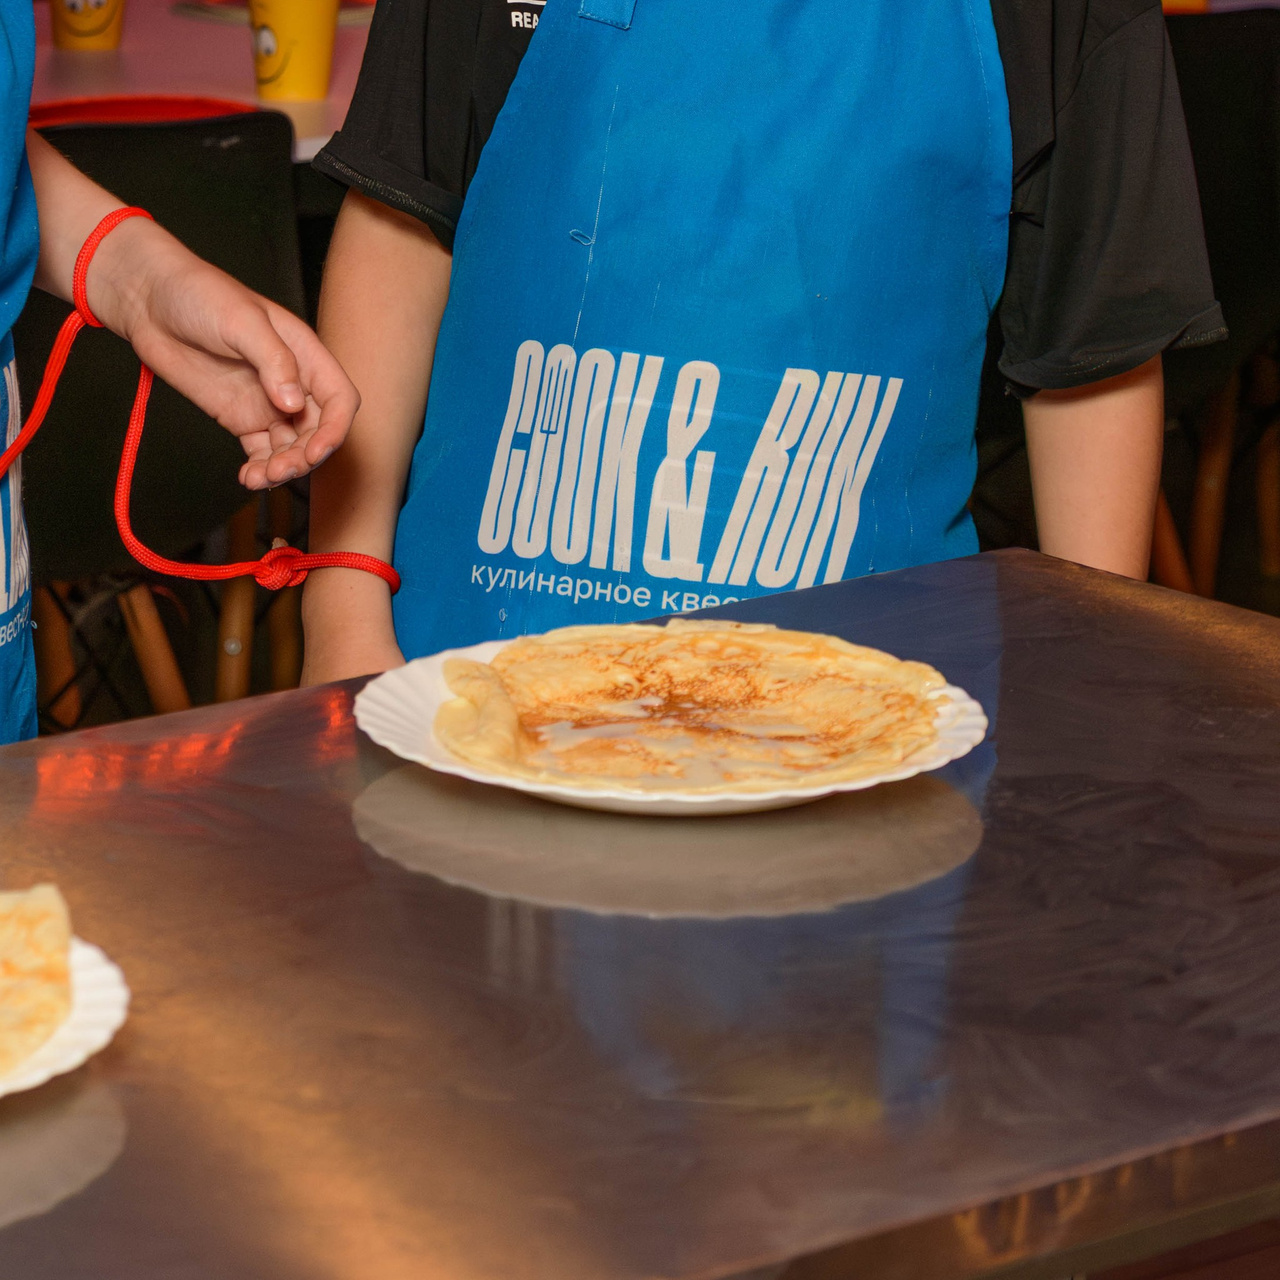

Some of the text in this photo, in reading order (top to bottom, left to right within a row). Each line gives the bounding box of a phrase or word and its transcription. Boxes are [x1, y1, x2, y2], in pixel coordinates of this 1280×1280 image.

[477, 339, 665, 573] COOK
[707, 367, 904, 590] RUN
[471, 564, 652, 608] кулинарное
